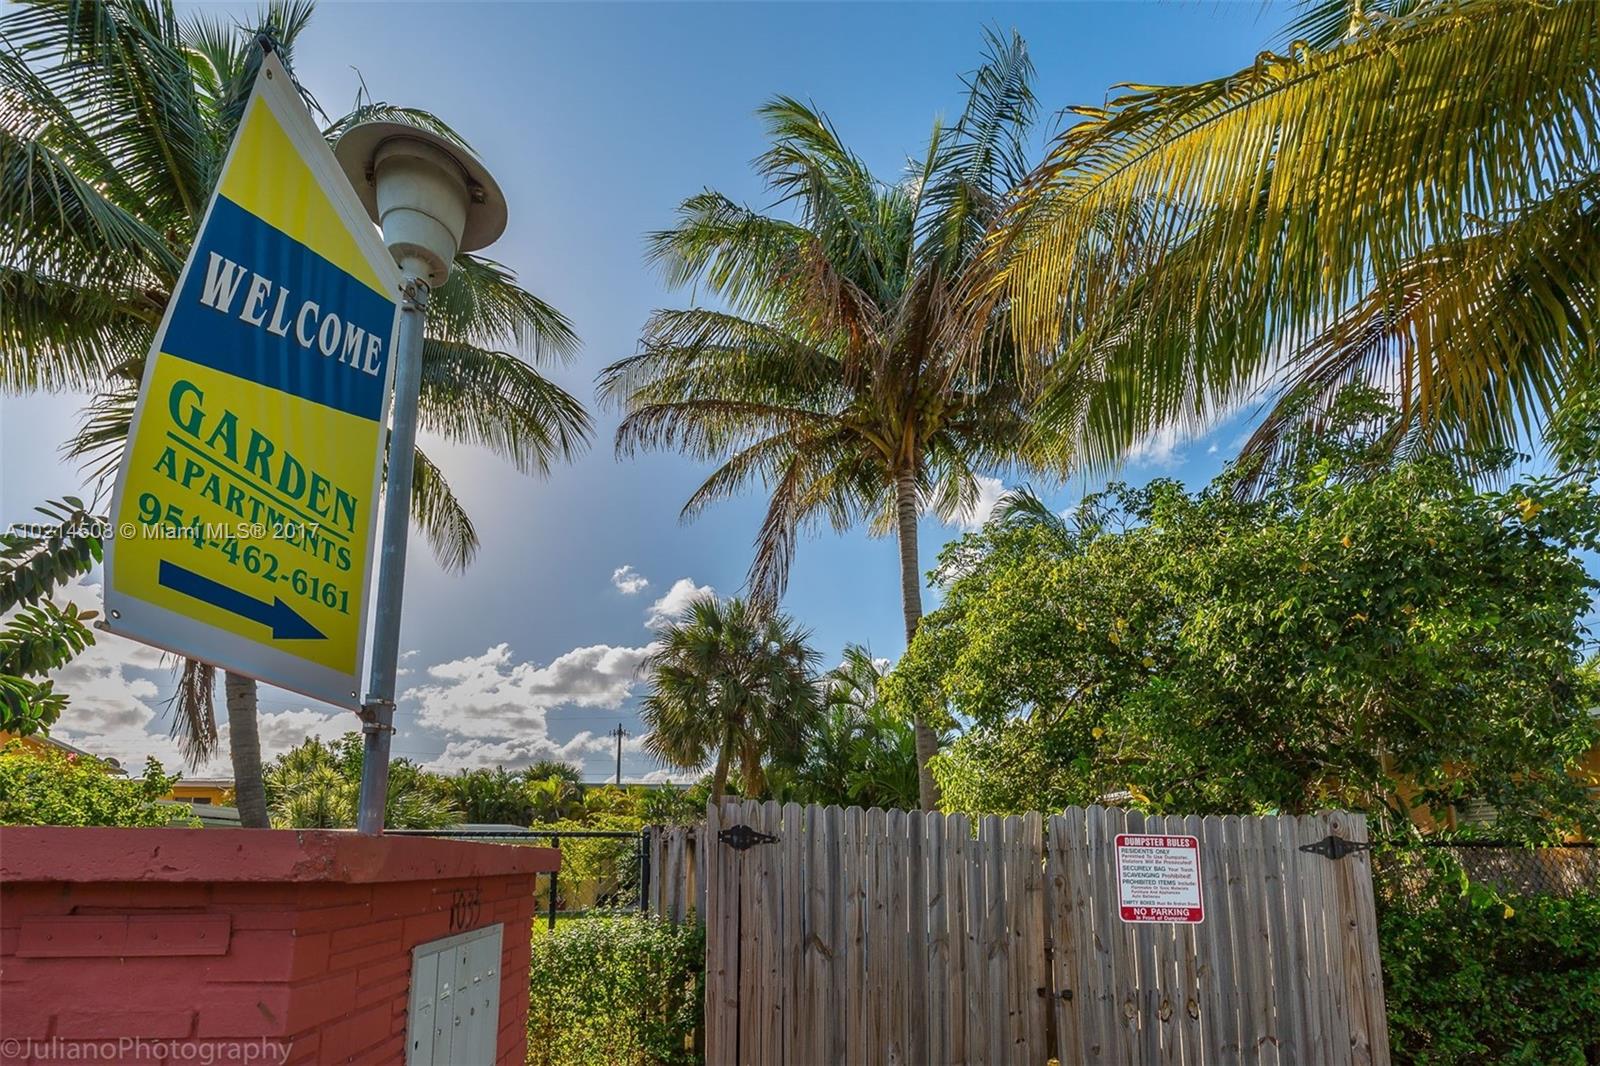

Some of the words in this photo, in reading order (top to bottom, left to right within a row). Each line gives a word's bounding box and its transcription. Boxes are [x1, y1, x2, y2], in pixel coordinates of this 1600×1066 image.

[200, 251, 382, 376] WELCOME
[153, 446, 351, 571] APARTMENTS
[169, 379, 358, 533] GARDEN
[137, 493, 350, 615] 954-462-6161
[1124, 837, 1164, 847] DUMPSTER
[1166, 838, 1190, 847] RULES
[1133, 907, 1147, 915] NO
[1150, 908, 1190, 916] PARKING
